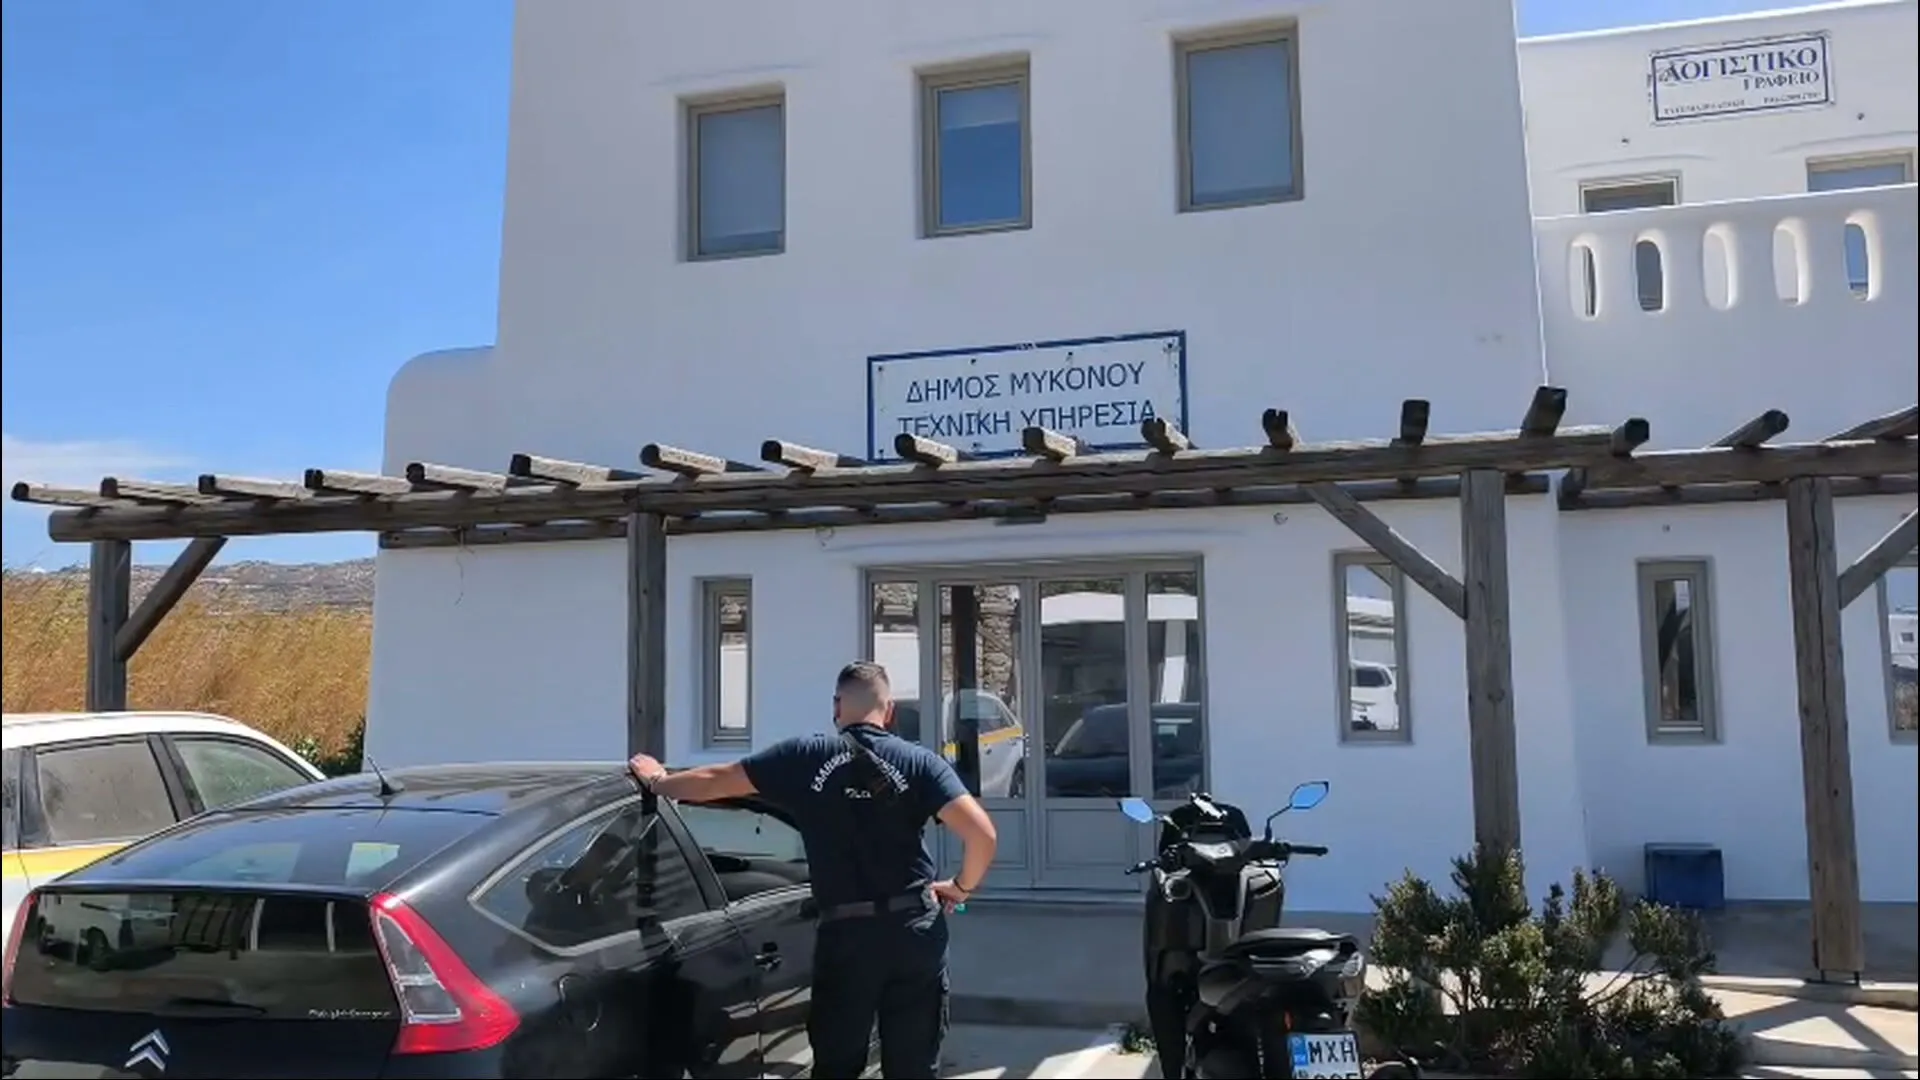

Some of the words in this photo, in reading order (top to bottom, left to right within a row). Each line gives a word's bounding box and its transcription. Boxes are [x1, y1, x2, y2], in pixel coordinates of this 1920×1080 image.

[906, 374, 1000, 403] ΔΗΜΟΣ
[1011, 361, 1145, 396] ΜΥΚΟΝΟΥ
[898, 410, 1011, 438] ΤΕΧΝΙΚΗ
[1020, 399, 1156, 429] ΥΠΗΡΕΣΙΑ
